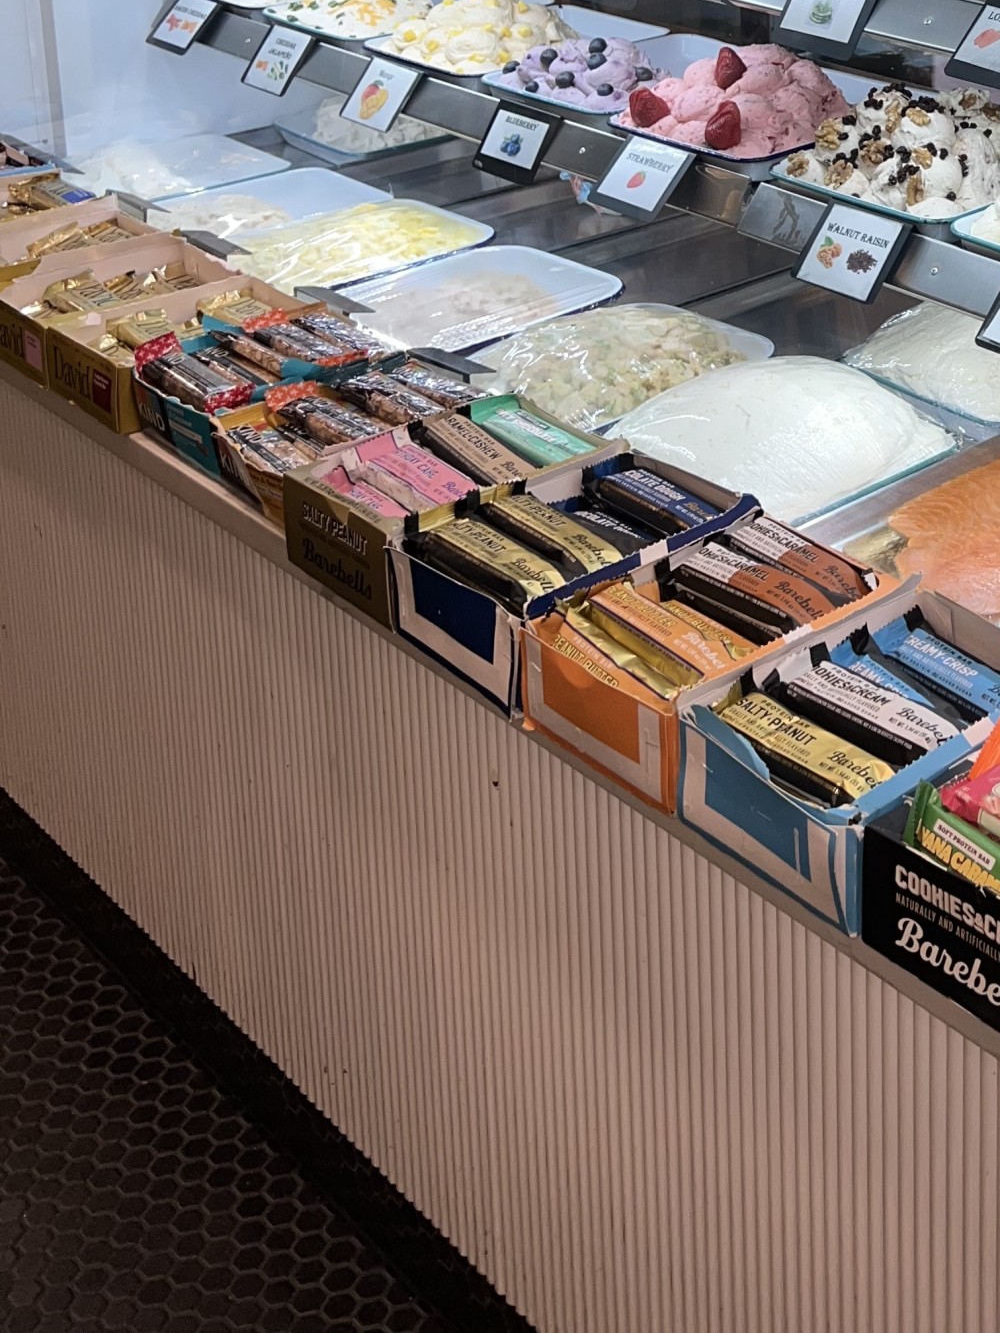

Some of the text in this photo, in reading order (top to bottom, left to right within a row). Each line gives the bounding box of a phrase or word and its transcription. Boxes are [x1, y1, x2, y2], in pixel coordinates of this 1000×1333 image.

[505, 115, 539, 131] BLUEBERRY
[626, 152, 675, 173] STRAWBERRY
[826, 222, 890, 249] WALNUT RAISIN
[925, 635, 973, 666] PROTEIN BAR
[937, 824, 991, 865] SOFT PROTEIN BAR
[895, 892, 936, 923] NATURALLY
[938, 916, 954, 933] AND
